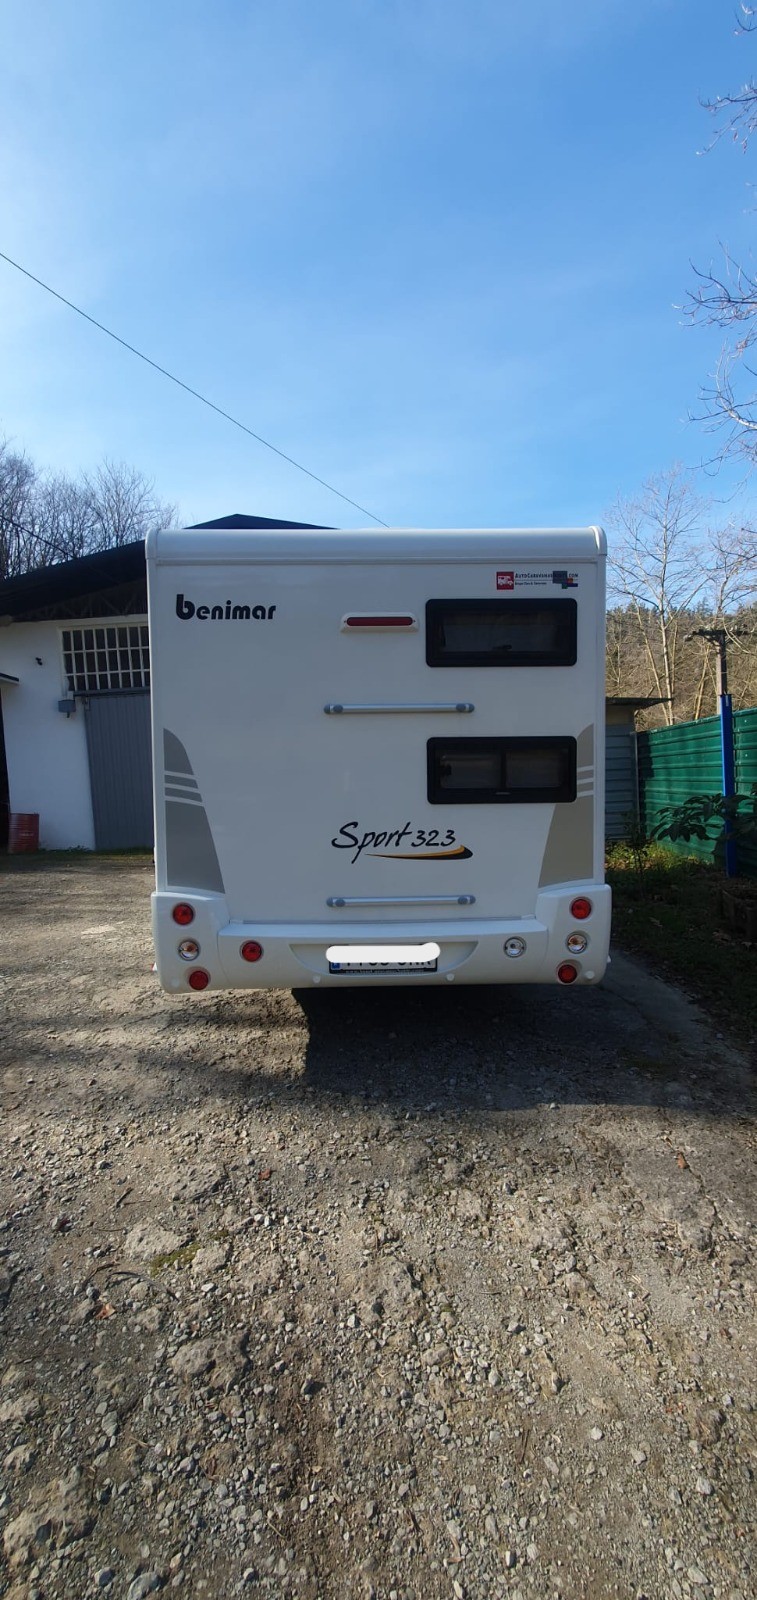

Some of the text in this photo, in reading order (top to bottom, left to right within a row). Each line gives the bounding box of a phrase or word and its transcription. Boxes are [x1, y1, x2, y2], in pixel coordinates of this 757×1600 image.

[176, 594, 276, 620] benimar
[331, 821, 456, 864] Sport 323
